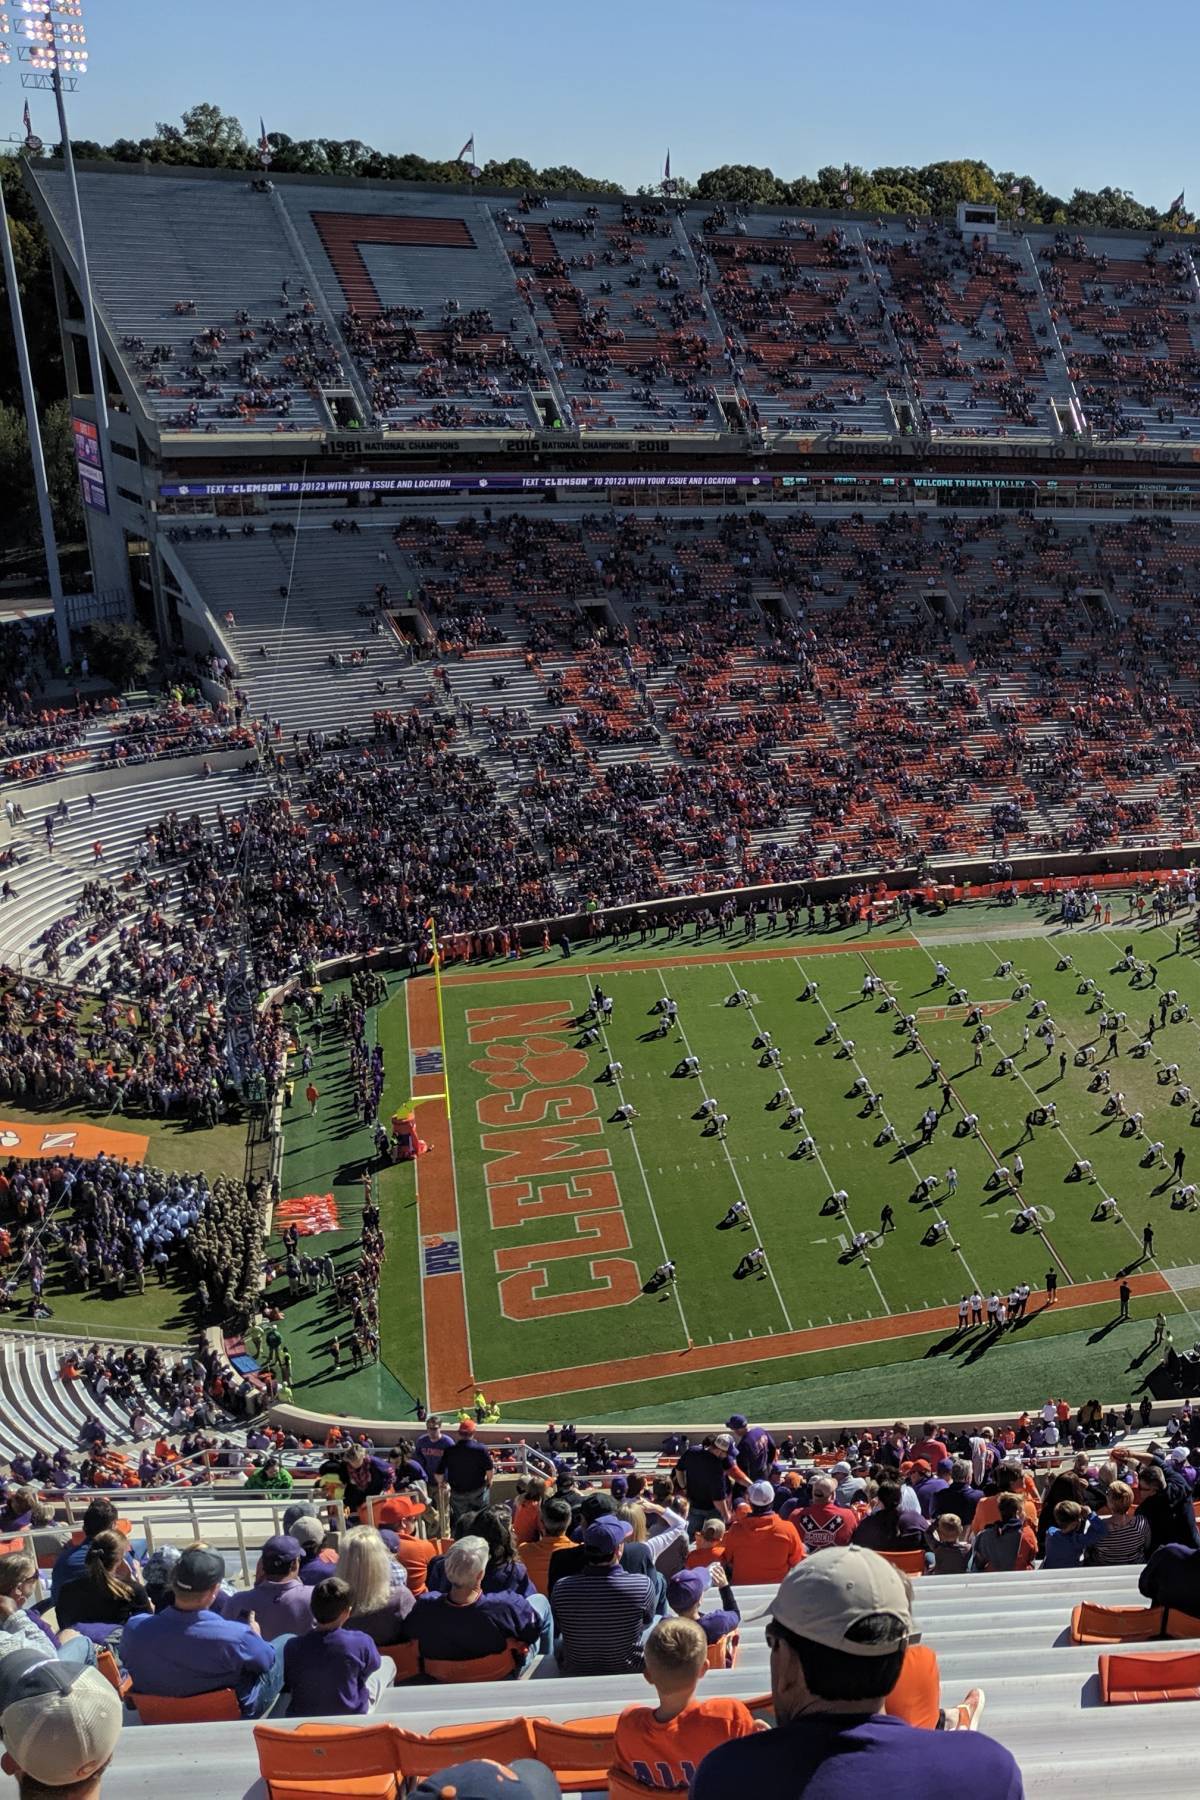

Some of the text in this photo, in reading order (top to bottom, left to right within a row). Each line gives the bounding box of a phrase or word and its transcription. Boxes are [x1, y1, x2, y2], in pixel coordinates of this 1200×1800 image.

[330, 440, 460, 452] 1981 NATIONAL CHAMPIONS
[507, 439, 631, 451] 2016 NATIONAL CHAMPIONS
[638, 440, 669, 451] 2018
[826, 441, 899, 456] Clemson
[911, 441, 1000, 459] Welcomes
[1008, 444, 1038, 458] You
[1075, 447, 1124, 460] Death
[1133, 449, 1181, 464] Valley
[206, 485, 226, 494] TEXT
[288, 483, 300, 491] TO
[301, 483, 326, 491] 20123
[327, 482, 348, 490] WITH
[350, 482, 370, 490] YOUR
[372, 481, 396, 489] ISSUE
[414, 479, 451, 488] LOCATION
[522, 478, 540, 486] TEXT
[604, 477, 626, 485] 20123
[628, 477, 646, 485] WITH
[647, 477, 666, 485] YOUR
[667, 477, 688, 485] ISSUE
[689, 477, 703, 485] AND
[704, 477, 736, 485] LOCATION
[913, 479, 1025, 489] WELCOME TO DEATH VALLEY
[464, 1000, 644, 1322] CLEMSN
